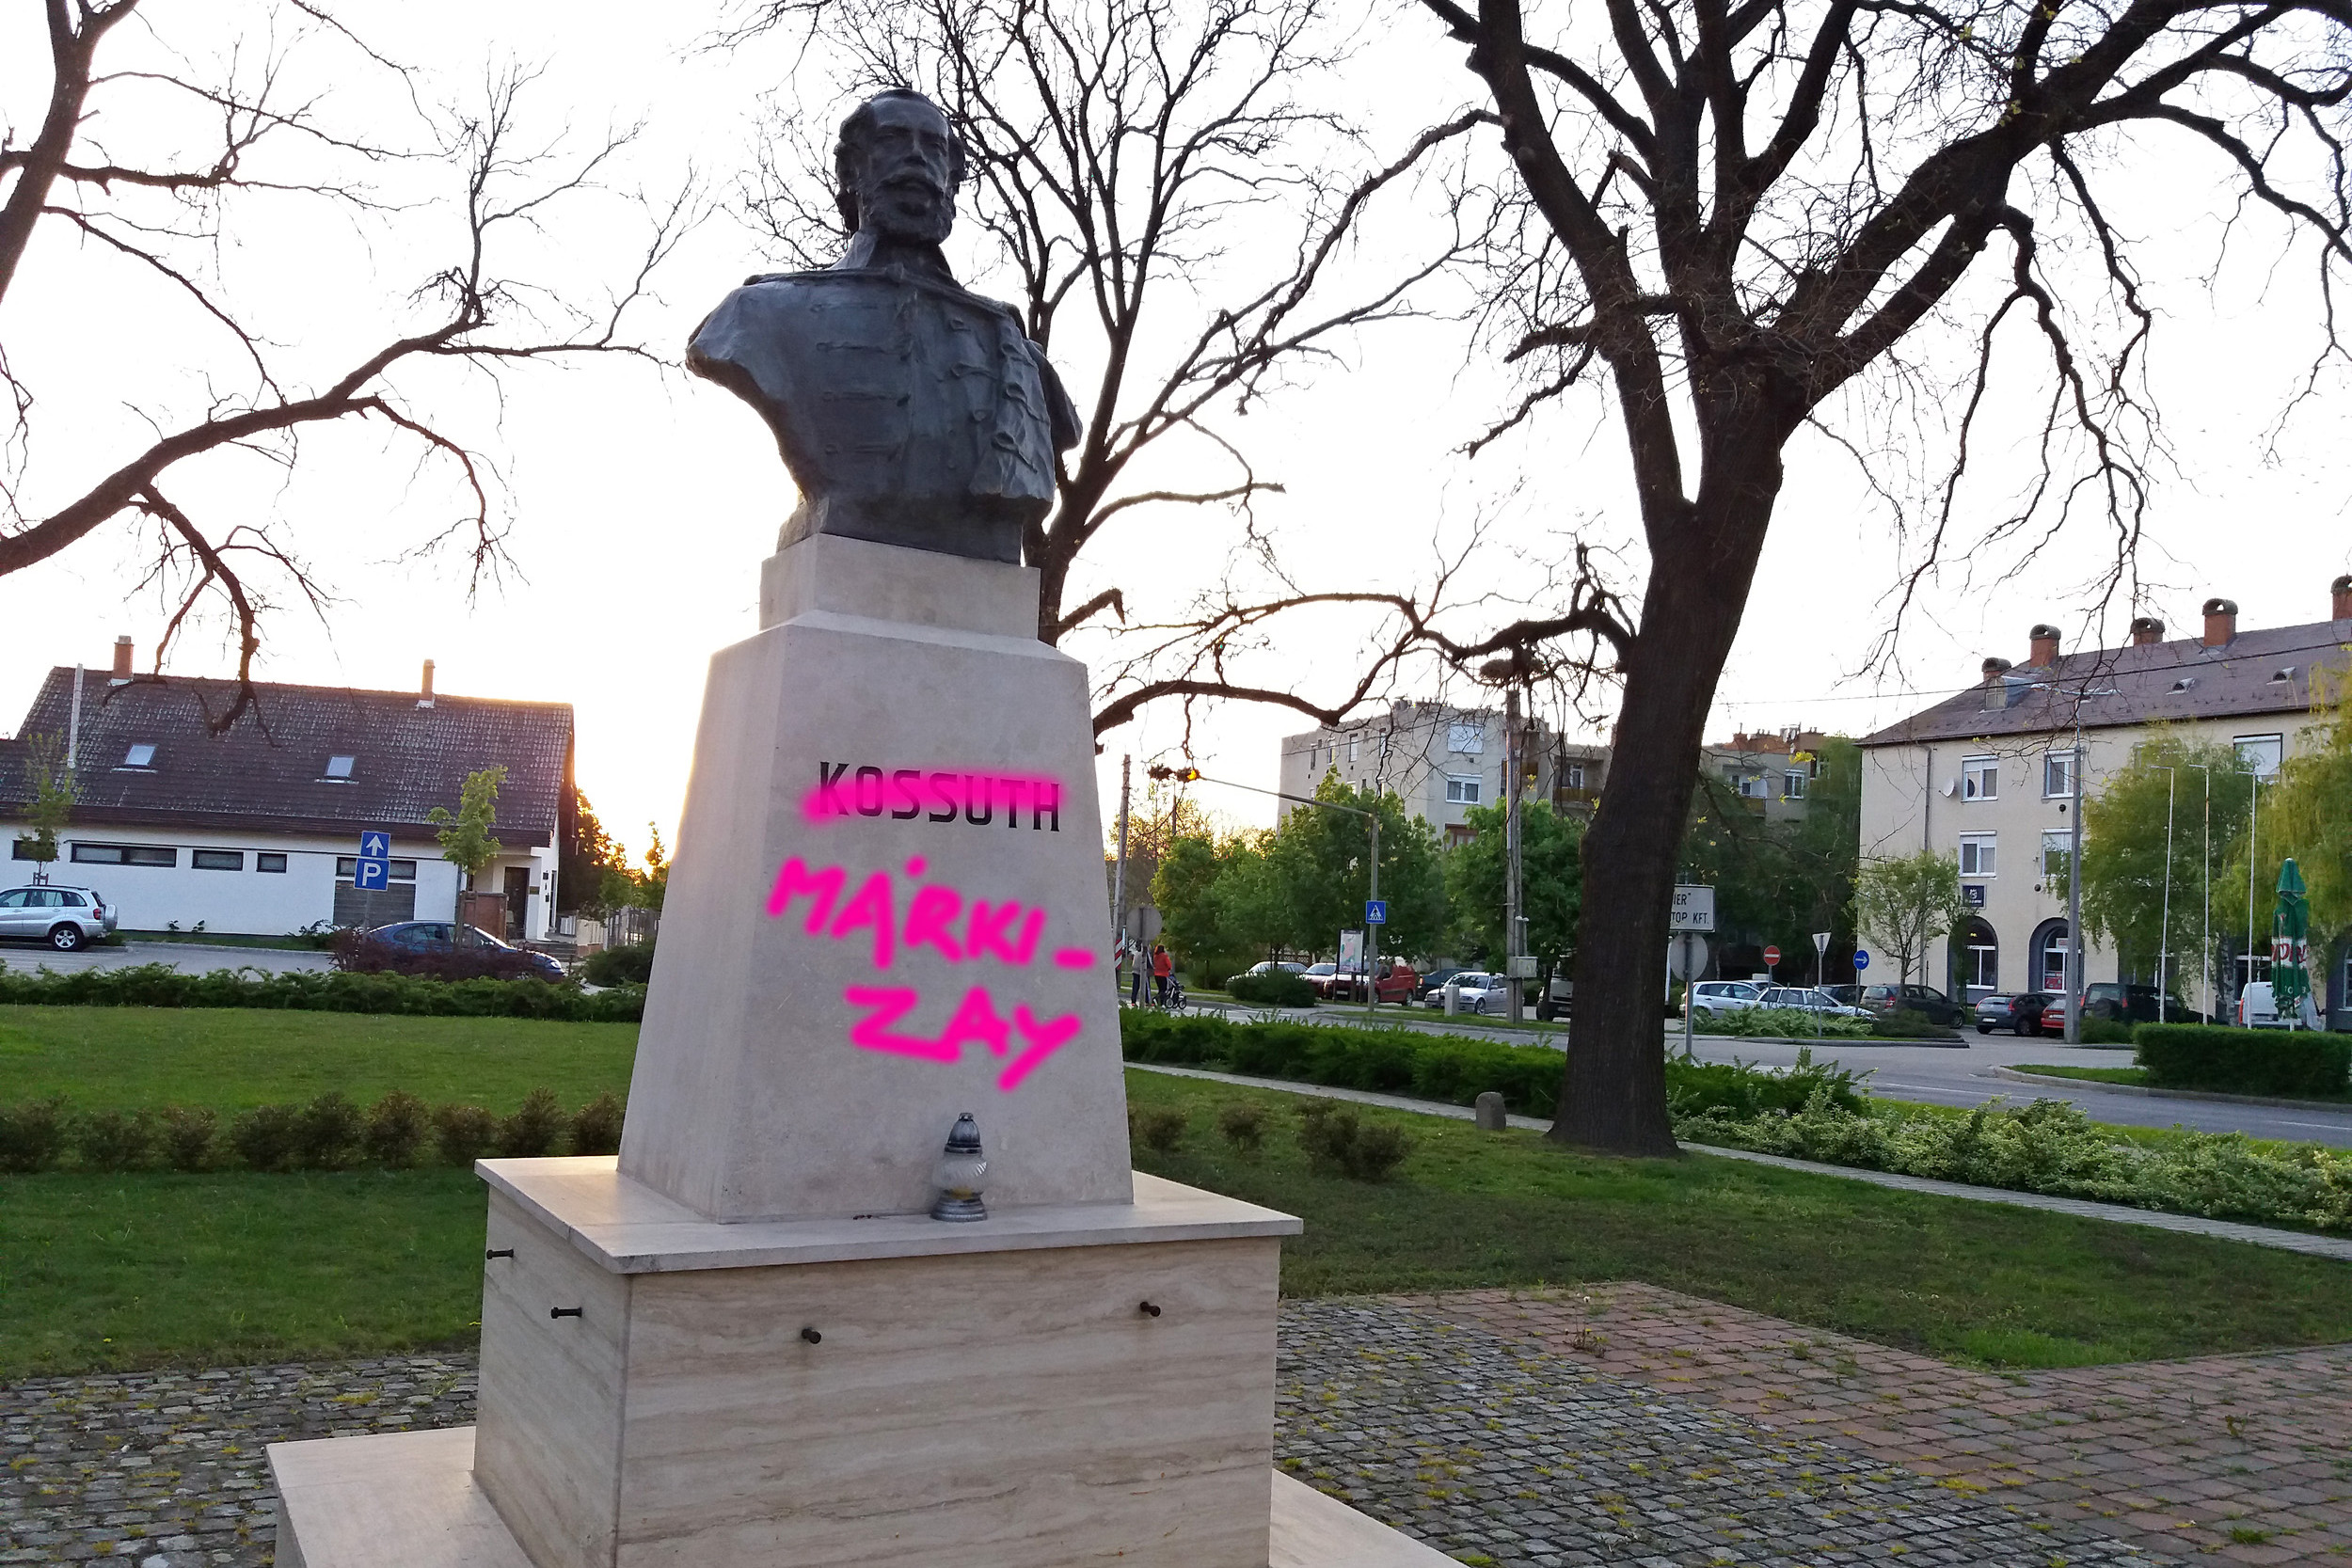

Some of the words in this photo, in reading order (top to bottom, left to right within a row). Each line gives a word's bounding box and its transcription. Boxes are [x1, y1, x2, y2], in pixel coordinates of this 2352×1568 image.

[819, 762, 1059, 832] KOSSUTH
[362, 863, 381, 886] P
[844, 985, 1081, 1093] ZAY
